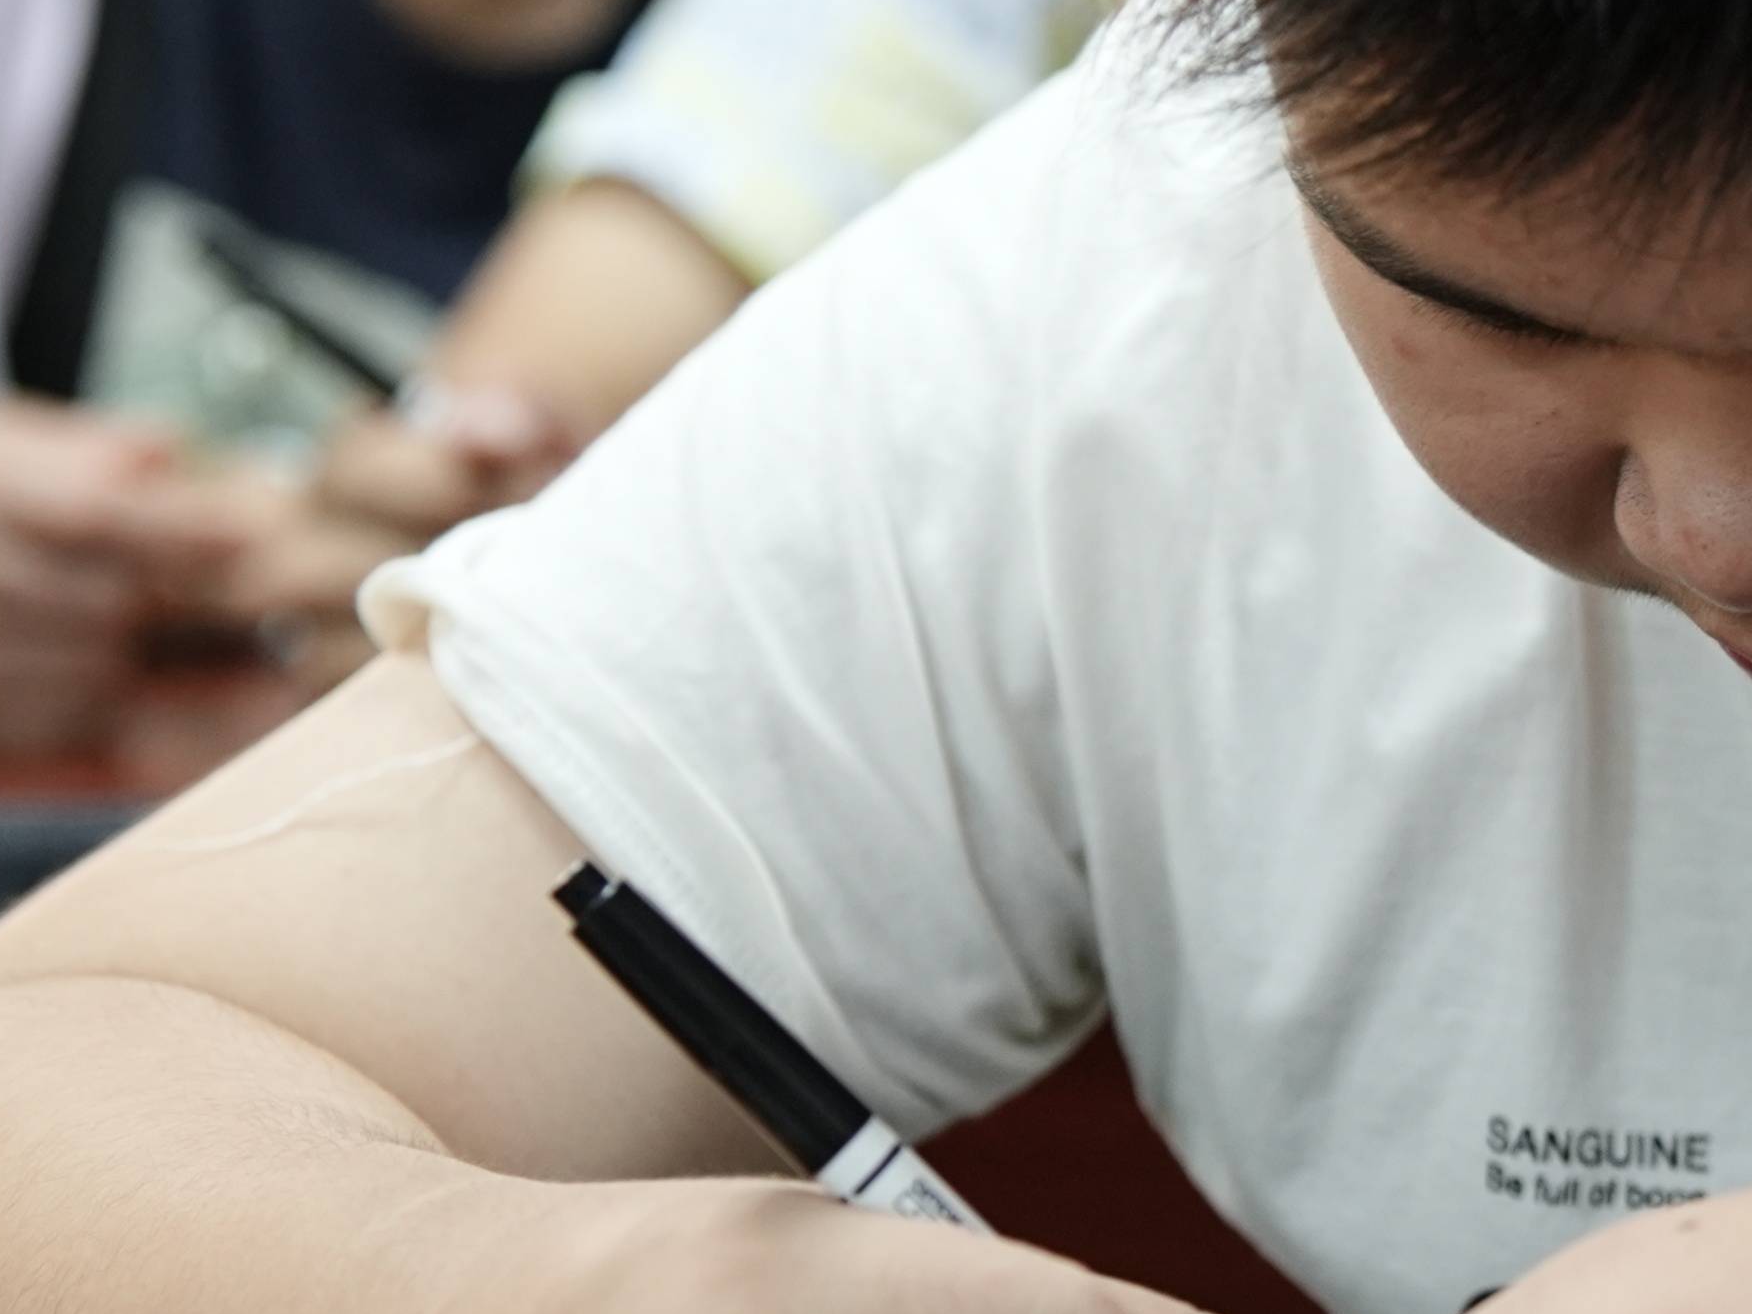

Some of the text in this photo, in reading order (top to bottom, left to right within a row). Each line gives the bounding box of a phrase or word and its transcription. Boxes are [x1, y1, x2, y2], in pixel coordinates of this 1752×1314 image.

[1486, 1115, 1711, 1174] SANGUINE
[1485, 1160, 1524, 1199] Be
[1534, 1174, 1581, 1206] full
[1588, 1176, 1618, 1209] of
